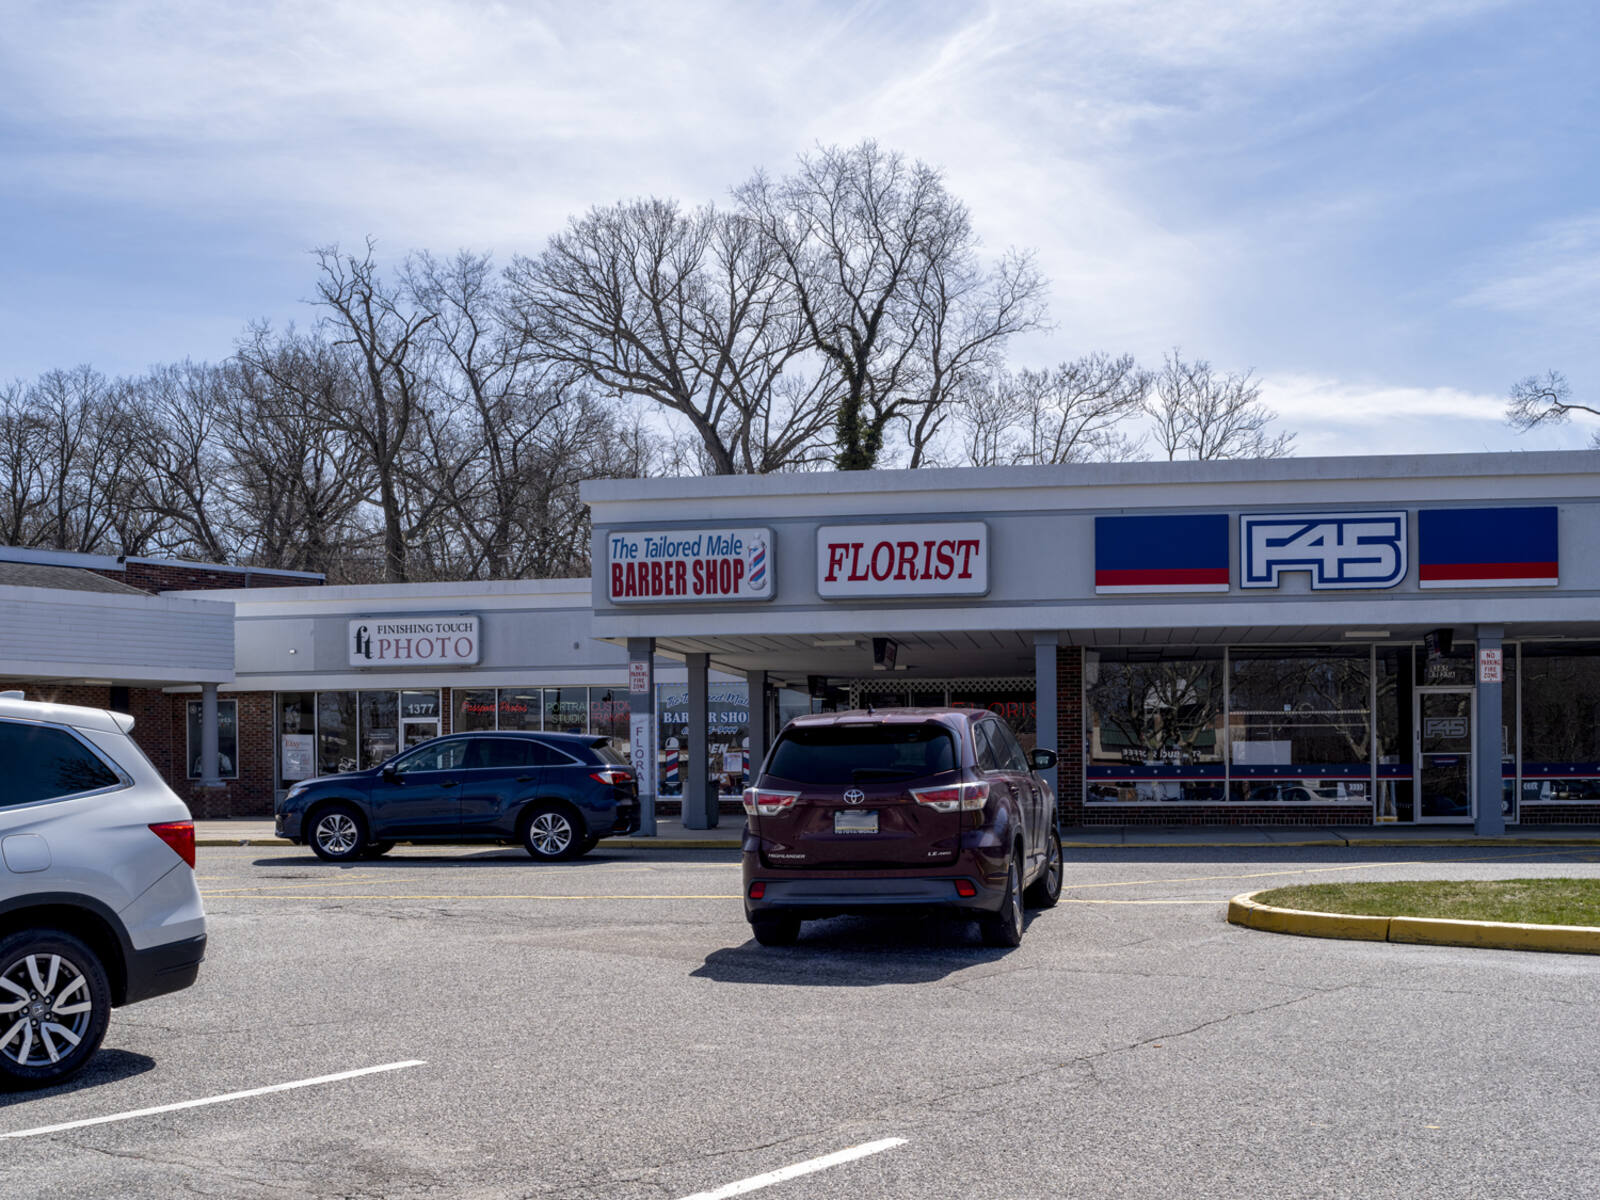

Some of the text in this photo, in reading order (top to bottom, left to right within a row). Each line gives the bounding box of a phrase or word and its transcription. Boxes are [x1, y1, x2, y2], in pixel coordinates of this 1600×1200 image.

[612, 533, 743, 559] The Tailored Male
[1247, 517, 1401, 583] F45
[824, 539, 980, 582] FLORIST
[611, 558, 744, 598] BARBER SHOP
[377, 622, 473, 635] FINISHING TOUCH
[377, 636, 474, 660] PHOTO
[407, 703, 434, 715] 1377
[499, 700, 528, 713] Photos
[545, 701, 587, 713] PORTRA
[551, 713, 587, 724] STUDIO
[591, 711, 631, 722] FRAMIN
[664, 711, 749, 723] BARR SHO
[1425, 718, 1467, 737] F45
